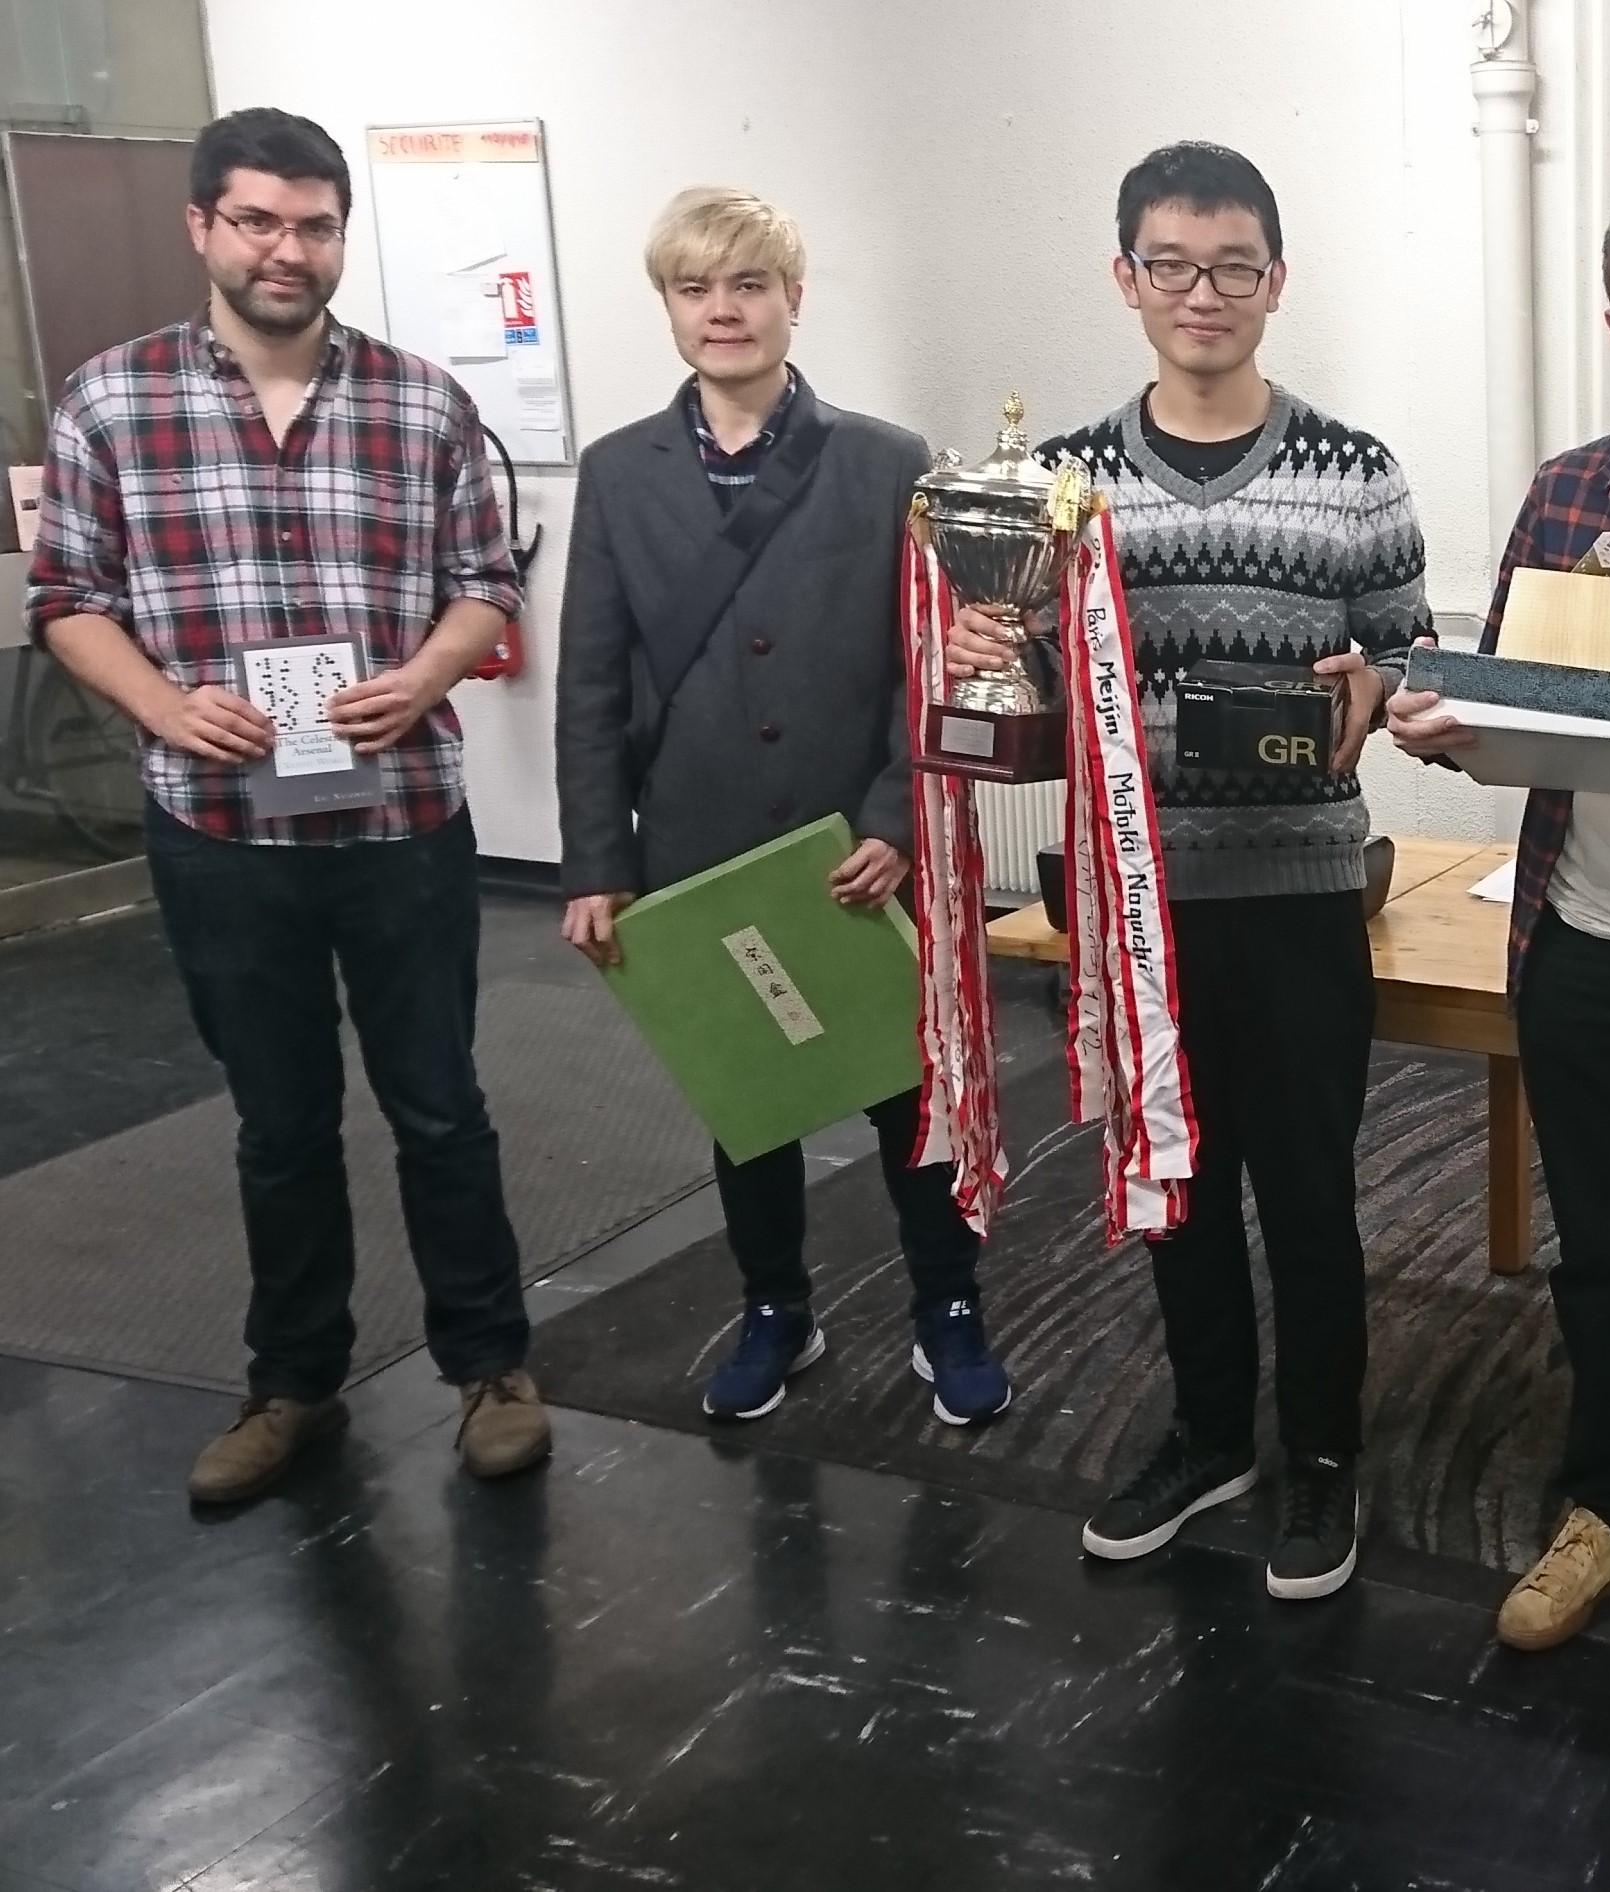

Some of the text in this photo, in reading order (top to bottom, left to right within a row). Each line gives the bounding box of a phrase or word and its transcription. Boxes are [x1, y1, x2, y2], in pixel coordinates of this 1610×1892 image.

[1095, 661, 1122, 736] Meijin
[1184, 692, 1215, 702] RICOH
[293, 743, 332, 757] Arsenal
[1184, 750, 1194, 758] GR
[1258, 734, 1318, 767] GR
[1108, 772, 1141, 853] Motoki
[1124, 872, 1154, 974] Noguchi
